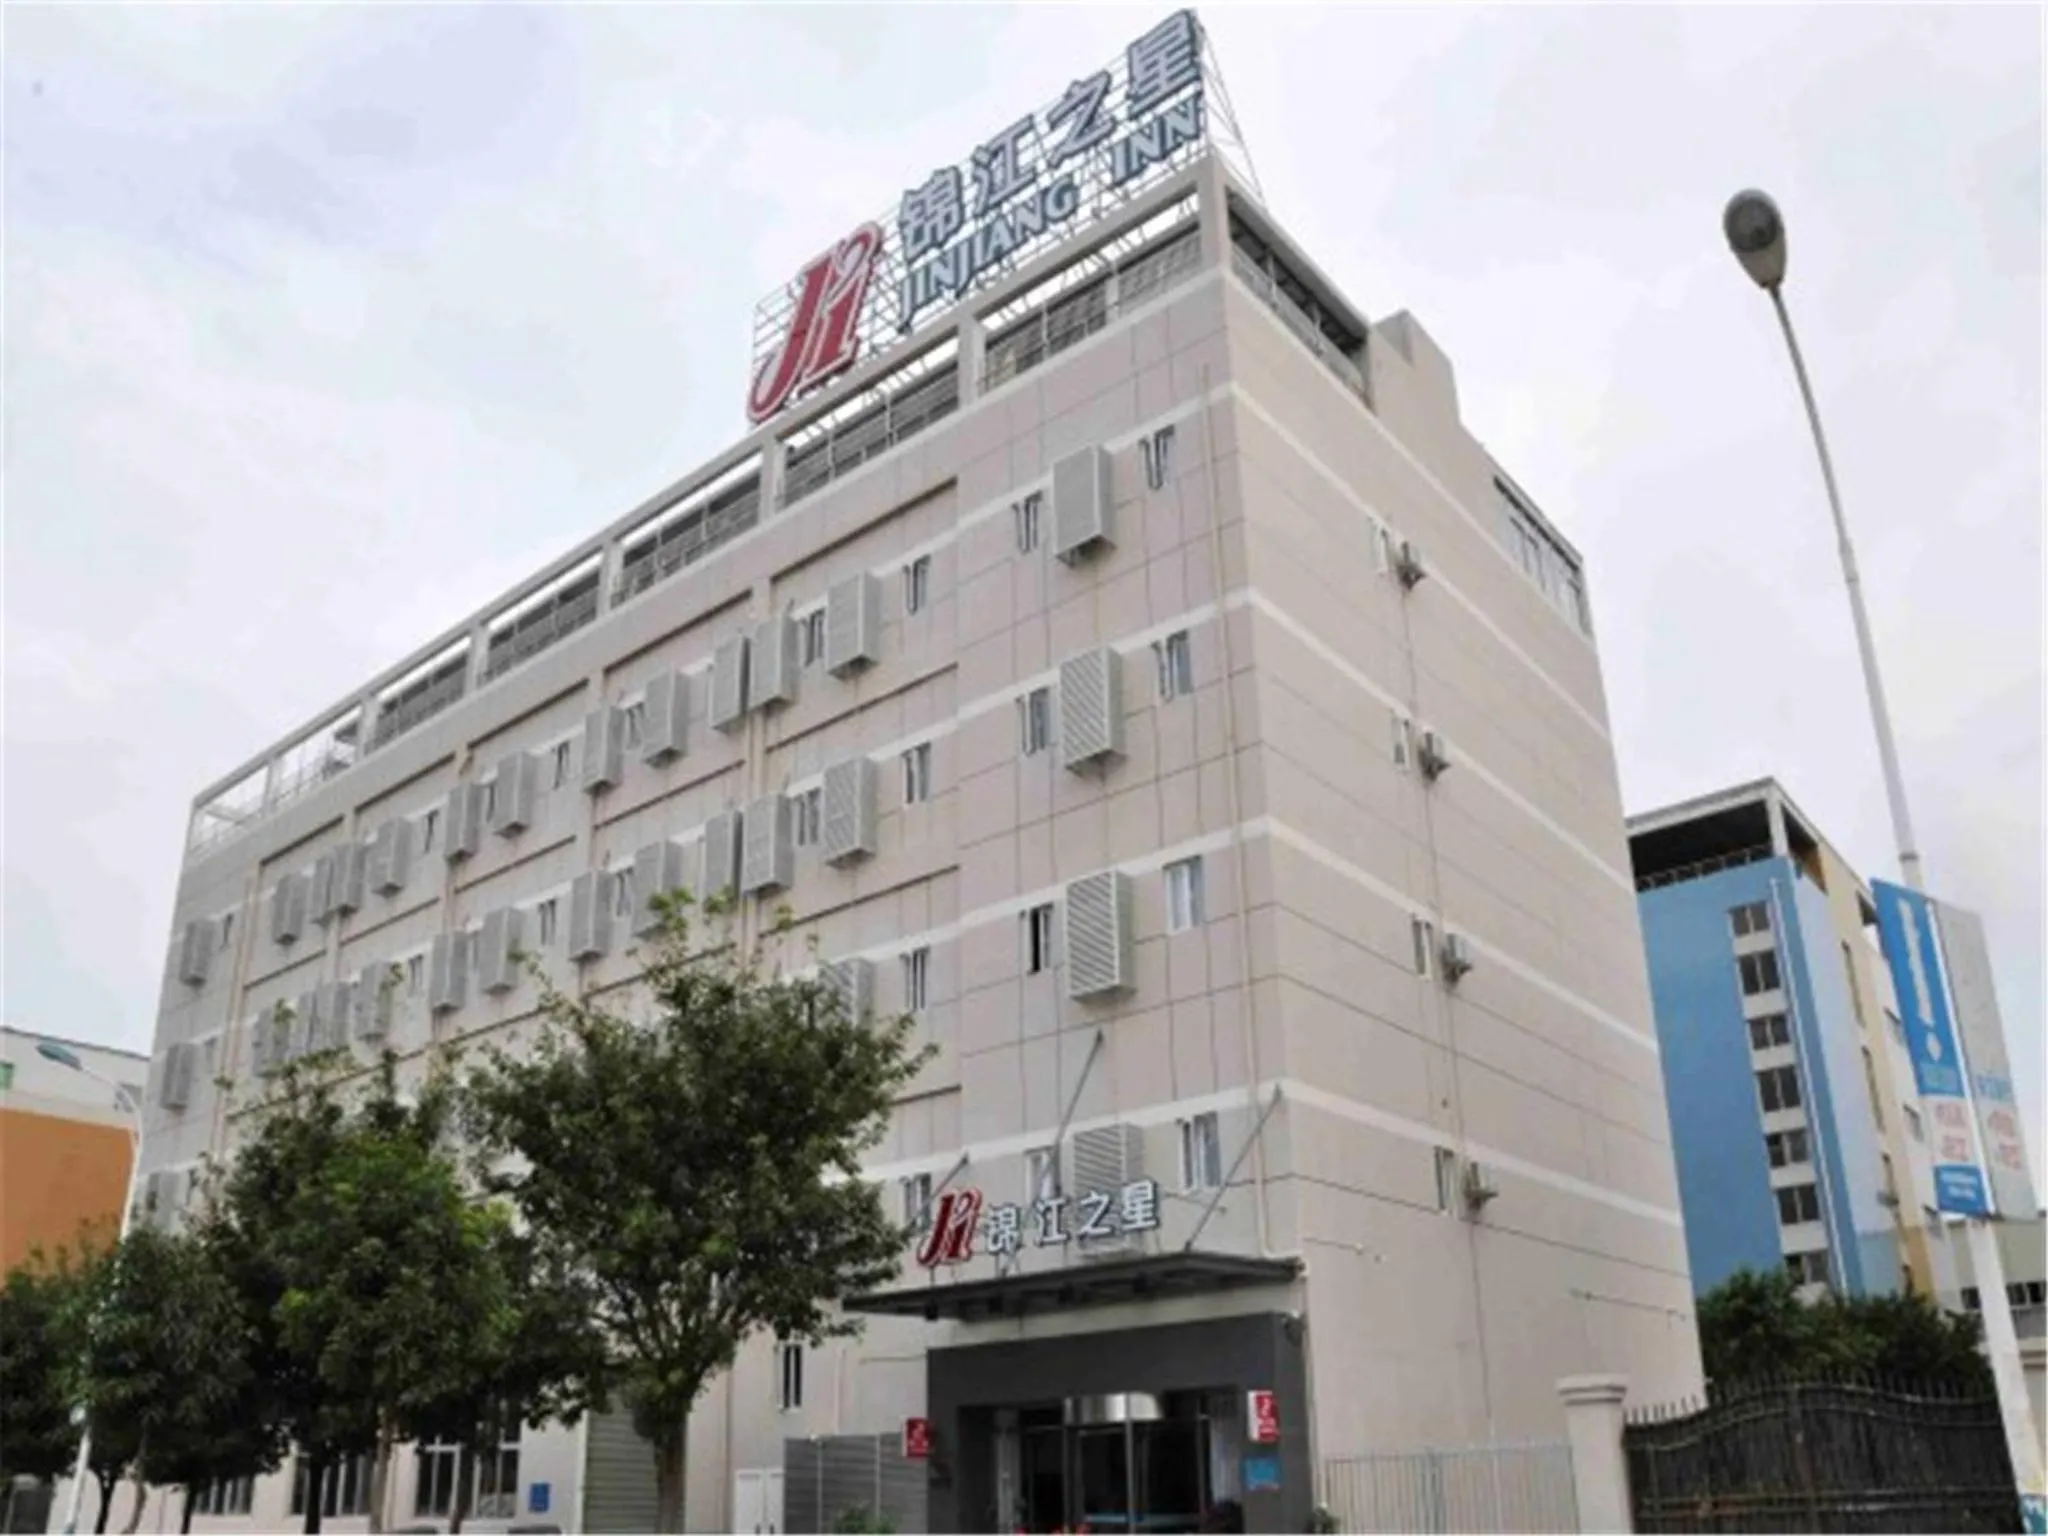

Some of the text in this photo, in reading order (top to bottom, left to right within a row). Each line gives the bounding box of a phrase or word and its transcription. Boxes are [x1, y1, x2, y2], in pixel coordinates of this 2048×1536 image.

[898, 90, 1204, 334] JINJIANG INN
[899, 8, 1203, 264] 锦江之星
[985, 1178, 1161, 1254] 锦江之星
